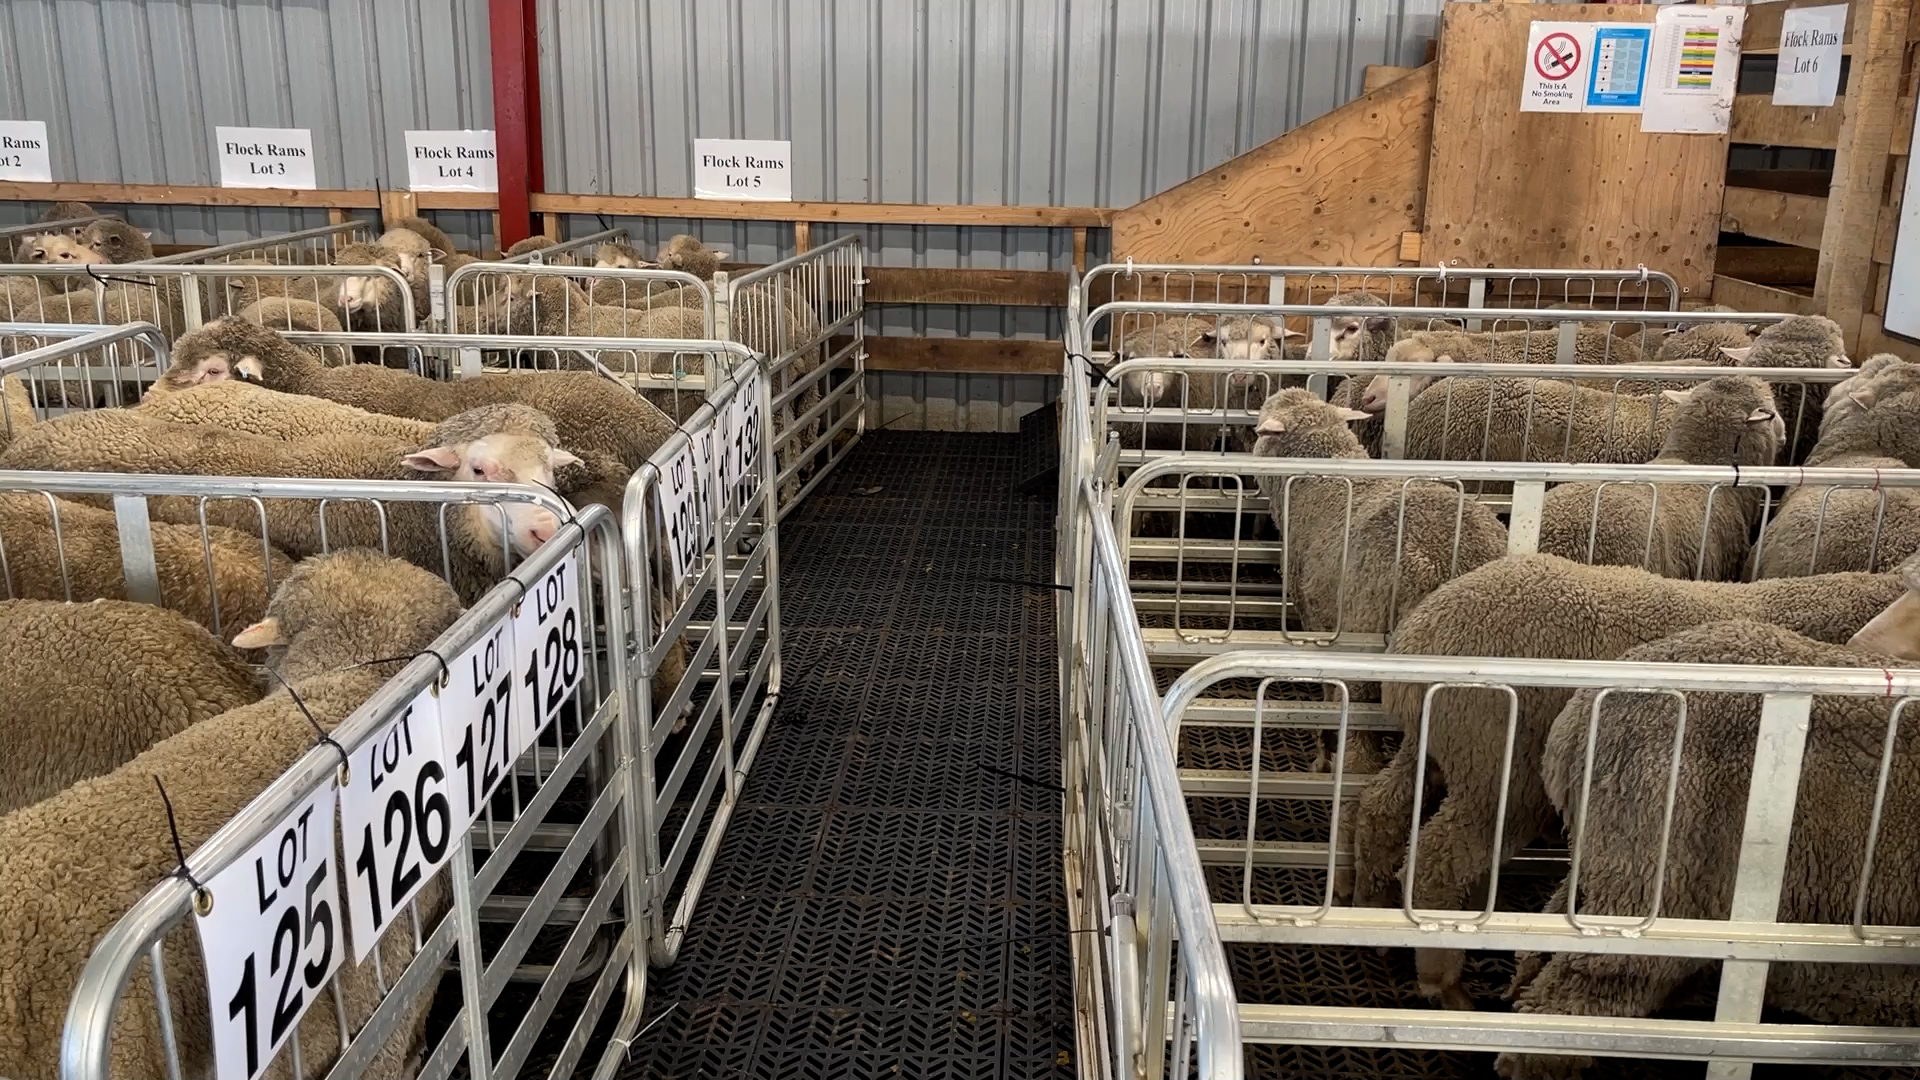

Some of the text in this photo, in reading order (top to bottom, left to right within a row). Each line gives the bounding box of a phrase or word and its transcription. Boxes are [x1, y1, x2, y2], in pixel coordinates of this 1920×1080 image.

[1783, 29, 1839, 48] Flock Rams
[1793, 56, 1819, 74] Lot 6
[1539, 82, 1553, 90] This
[1543, 90, 1573, 99] Smoking
[3, 136, 41, 149] Rams
[225, 142, 306, 157] Flock Rams
[414, 146, 495, 159] Flock Rams
[0, 155, 21, 167] ot 2
[250, 161, 286, 175] Lot 3
[438, 165, 474, 178] Lot 4
[703, 154, 784, 169] Flock Rams
[726, 174, 761, 188] Lot 5
[743, 377, 756, 412] LOT
[735, 405, 759, 476] 132
[670, 453, 686, 496] LOT
[671, 491, 696, 576] 129
[536, 562, 567, 624] LOT
[472, 625, 504, 697] LOT
[524, 606, 579, 732] 128
[371, 704, 413, 792] LOT
[456, 670, 513, 818] 127
[255, 803, 314, 915] LOT
[356, 760, 451, 933] 126
[229, 856, 334, 1080] 125
